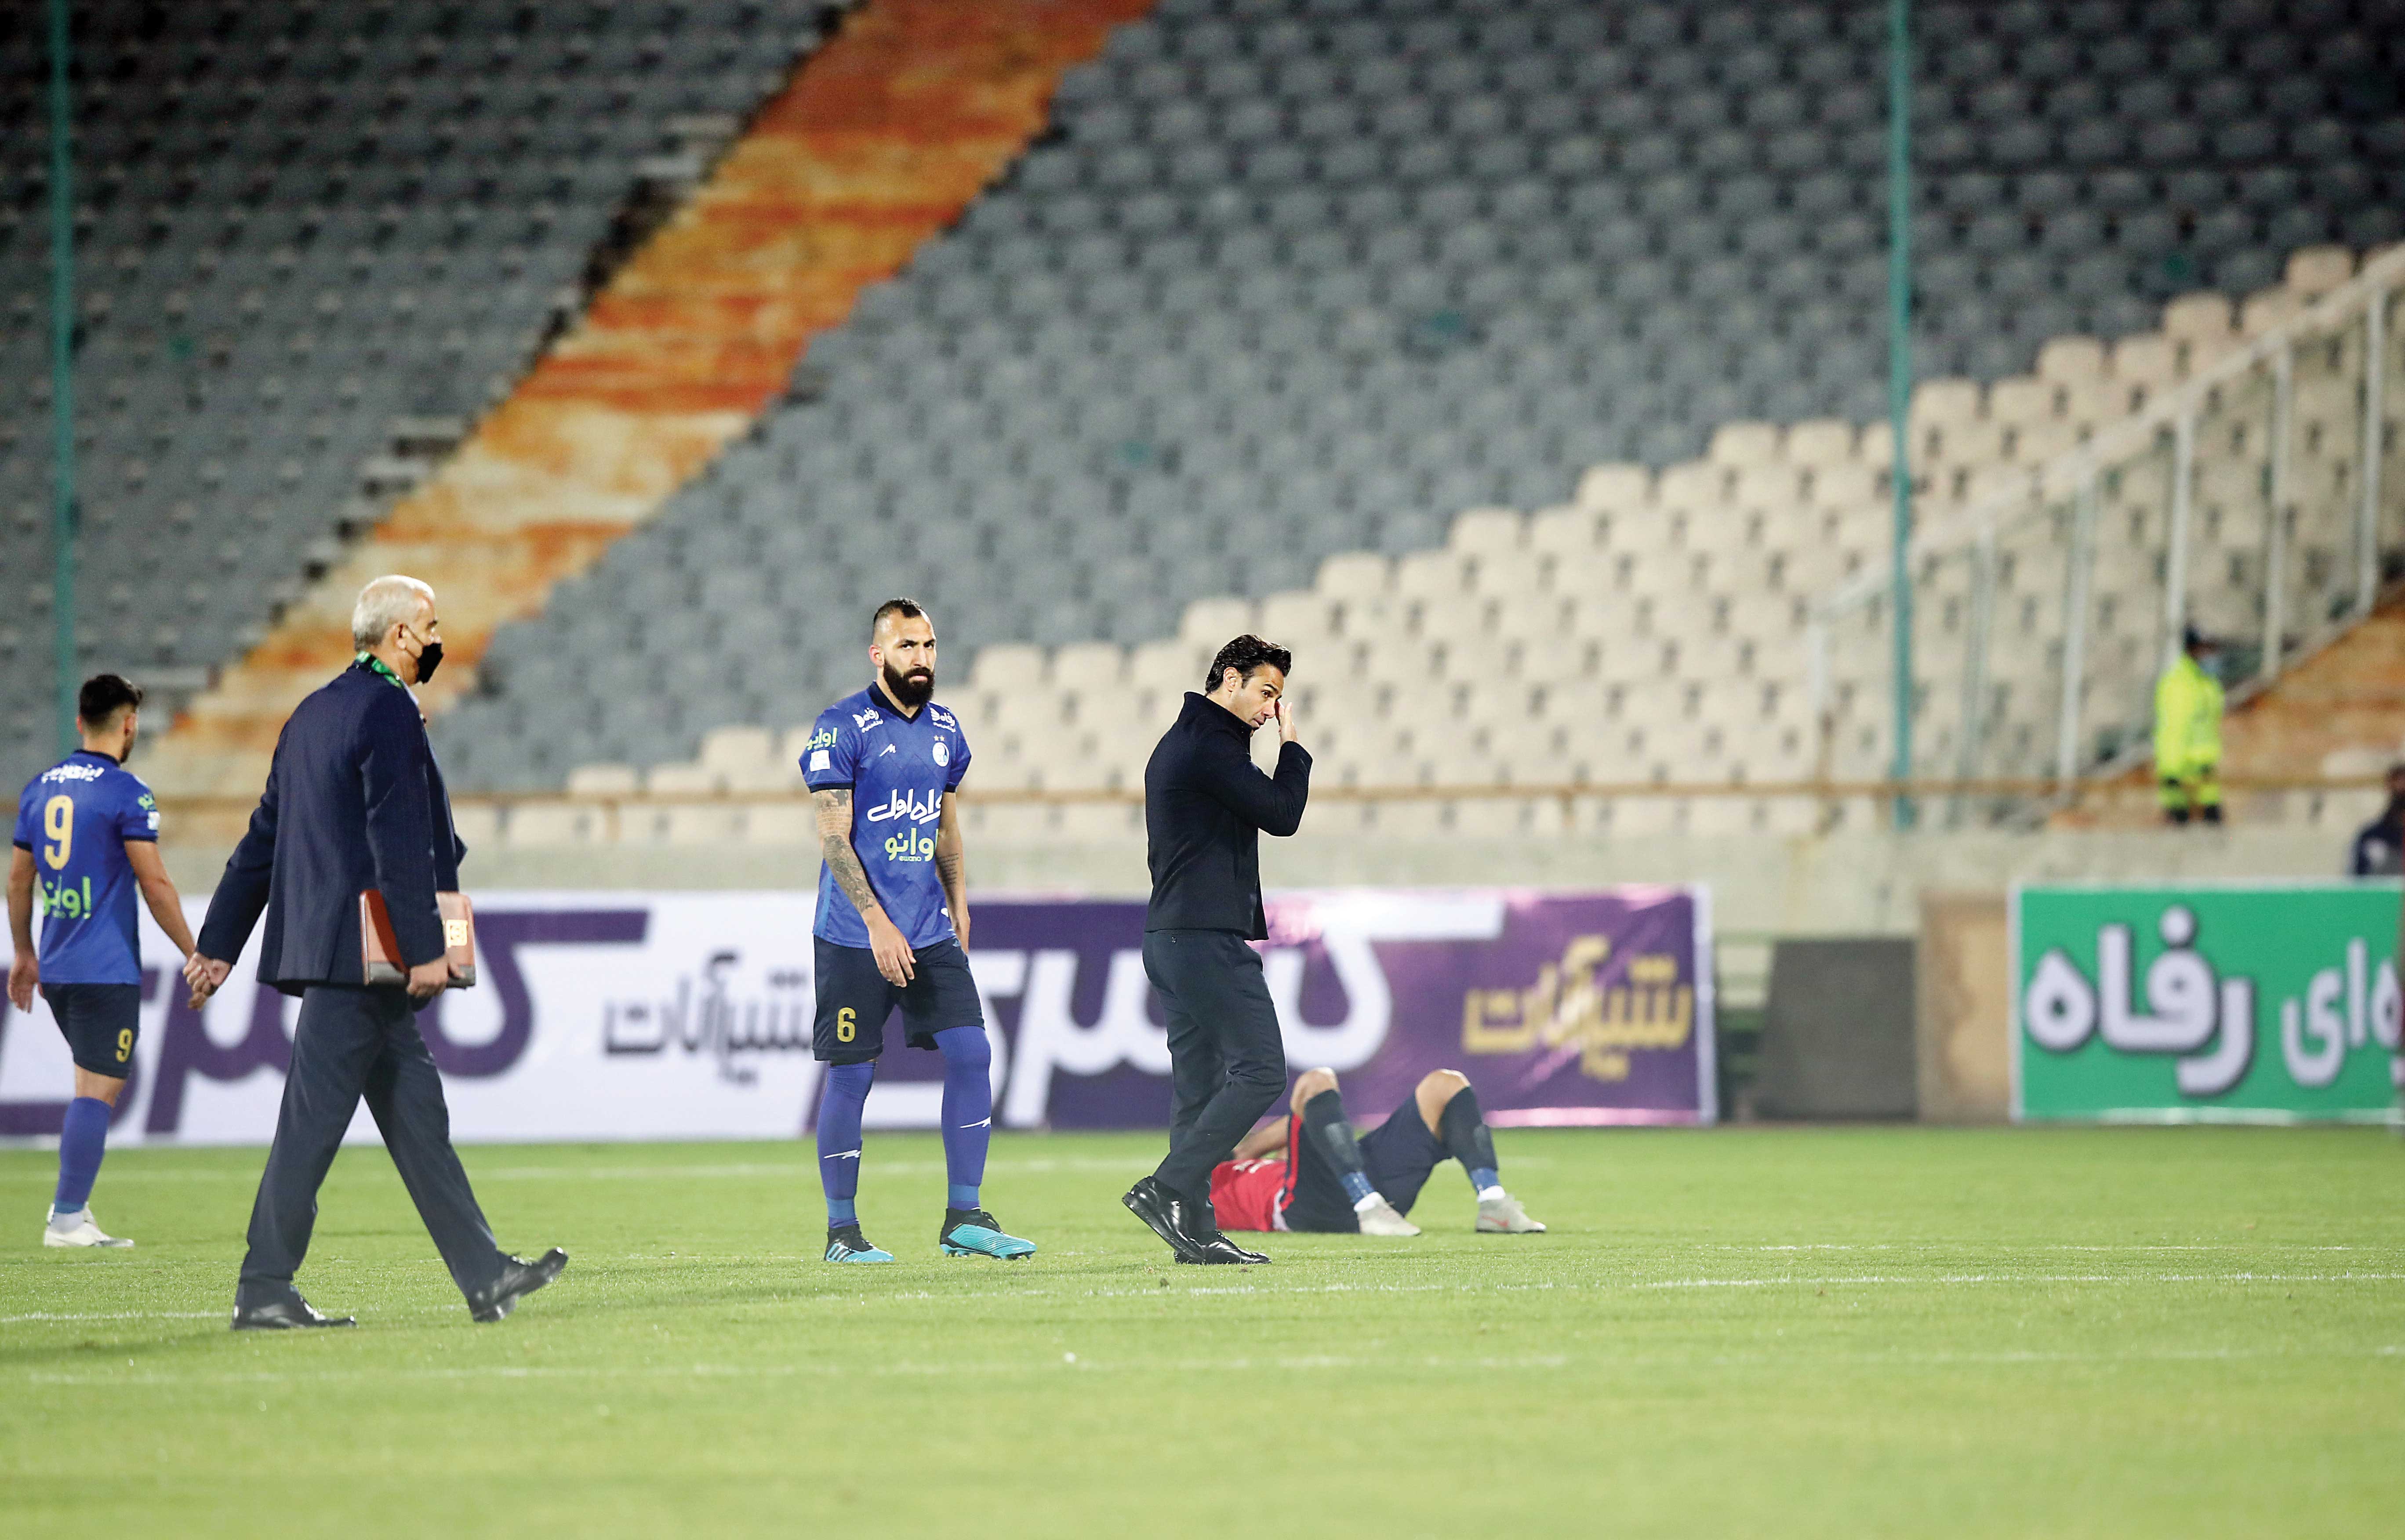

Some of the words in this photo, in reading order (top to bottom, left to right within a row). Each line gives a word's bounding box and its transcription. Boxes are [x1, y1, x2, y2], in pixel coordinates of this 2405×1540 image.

[863, 707, 879, 721] رفاه
[940, 712, 955, 726] رفاه
[910, 789, 943, 825] راه
[45, 795, 74, 870] 9
[2026, 904, 2256, 1097] رفاه
[837, 1007, 856, 1042] 6
[116, 1028, 133, 1062] 9
